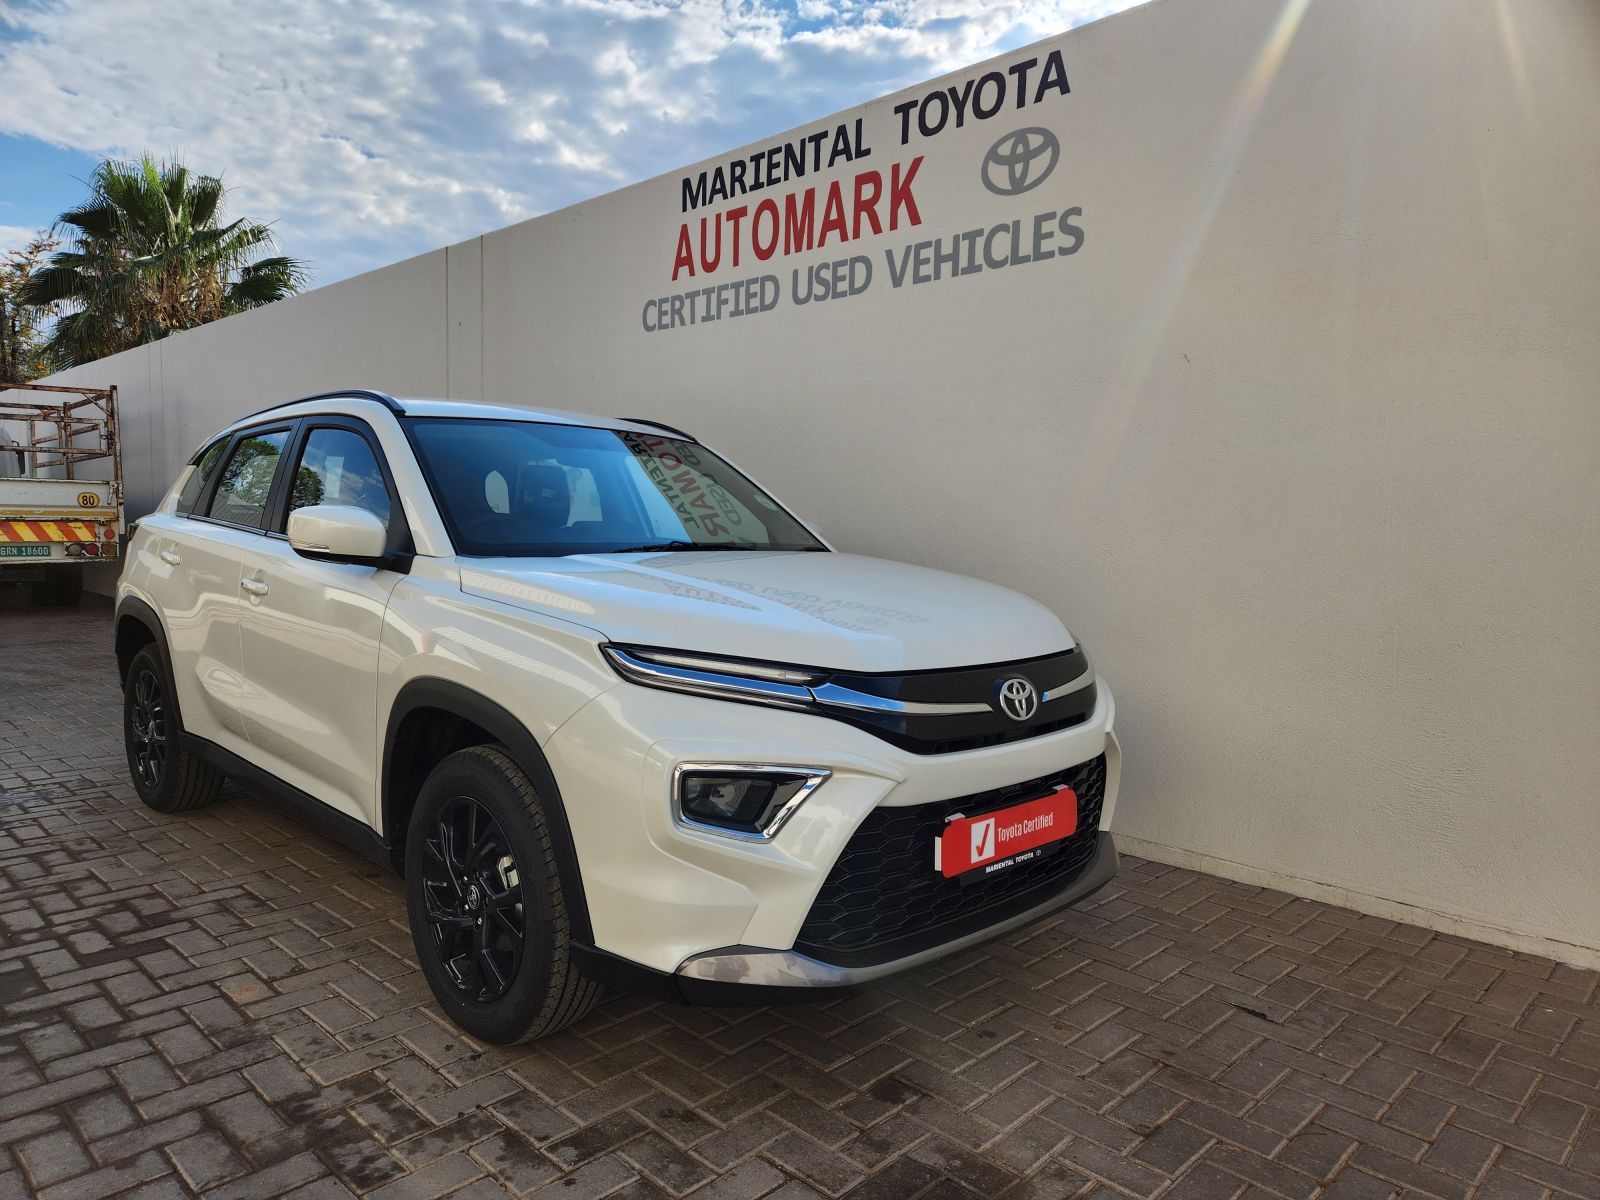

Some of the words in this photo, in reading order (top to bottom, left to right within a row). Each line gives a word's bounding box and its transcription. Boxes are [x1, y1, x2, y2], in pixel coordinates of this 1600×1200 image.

[681, 118, 871, 212] MARIENTAL
[894, 49, 1071, 145] TOYOTA
[671, 155, 925, 281] AUTOMARK
[642, 274, 780, 332] CERTIFIED
[791, 255, 873, 305] USED
[885, 206, 1085, 288] VEHICLES
[82, 495, 95, 506] 80
[0, 546, 18, 556] GRN
[997, 822, 1023, 843] Toyota
[1023, 812, 1054, 834] Certified
[985, 858, 1015, 874] MARIENTAL
[1015, 851, 1034, 864] TOYOTA
